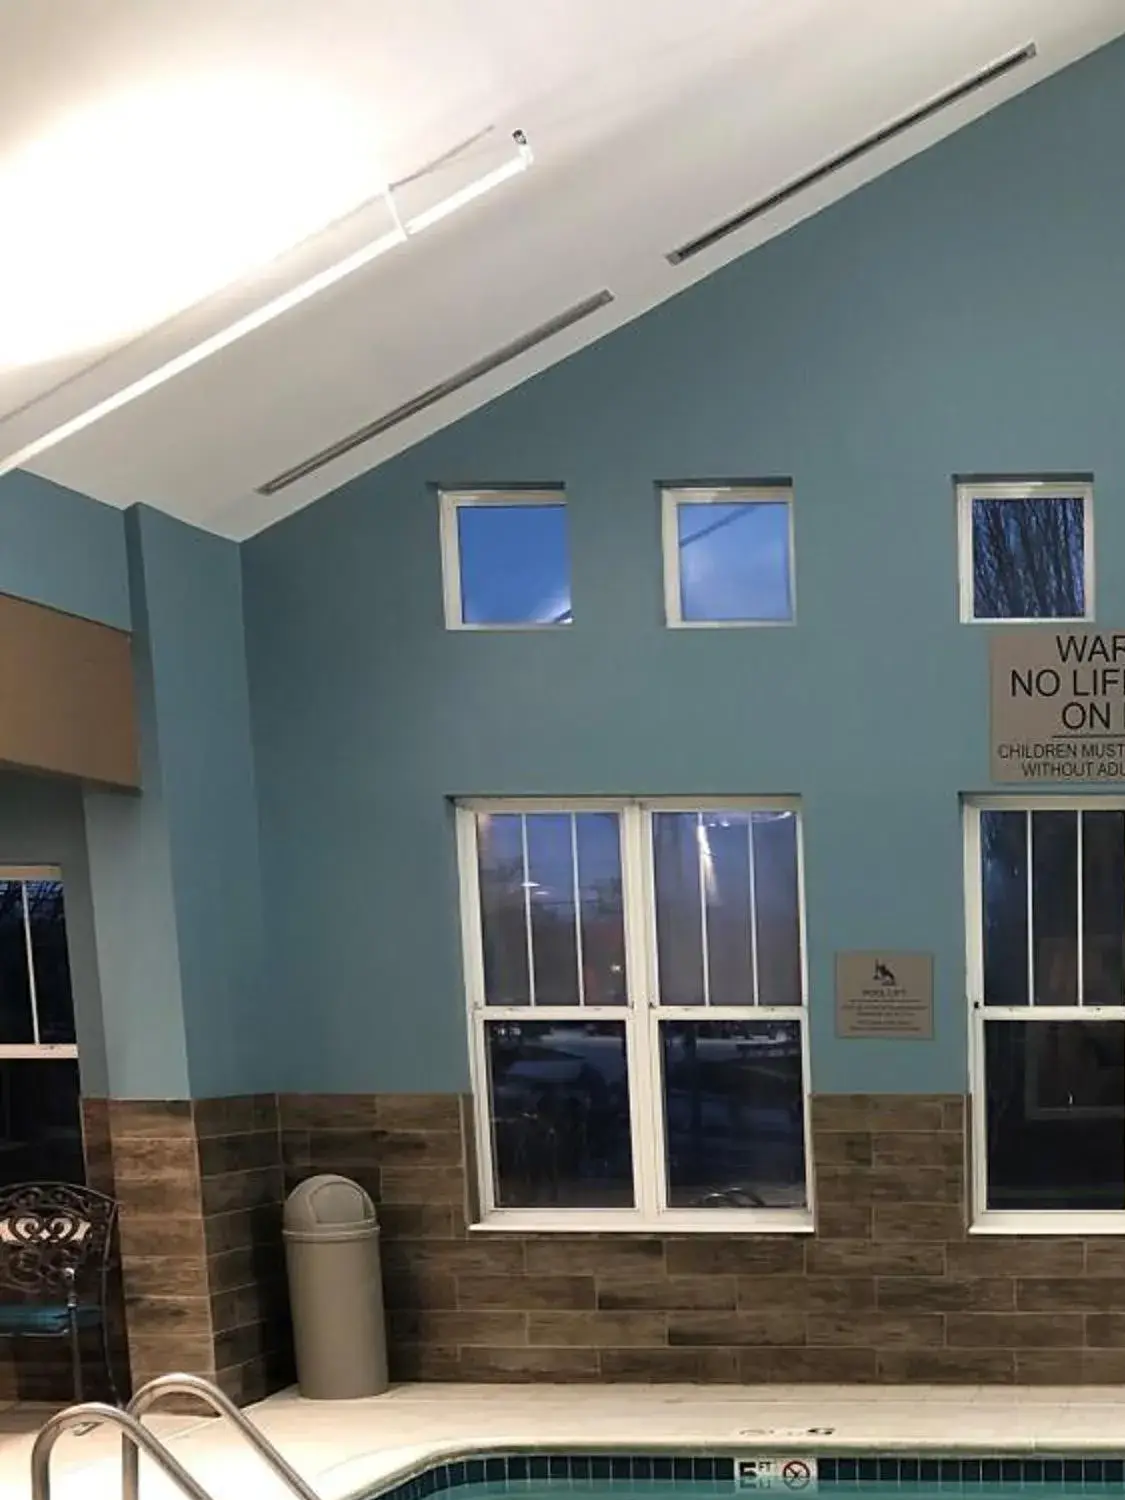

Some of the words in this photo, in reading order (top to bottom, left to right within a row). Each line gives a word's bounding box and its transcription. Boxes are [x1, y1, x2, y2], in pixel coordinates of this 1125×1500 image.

[1010, 669, 1060, 697] NO
[1061, 702, 1110, 729] ON
[998, 743, 1077, 759] CHILDREN
[1081, 743, 1124, 758] MUST
[1022, 762, 1095, 777] WITHOUT
